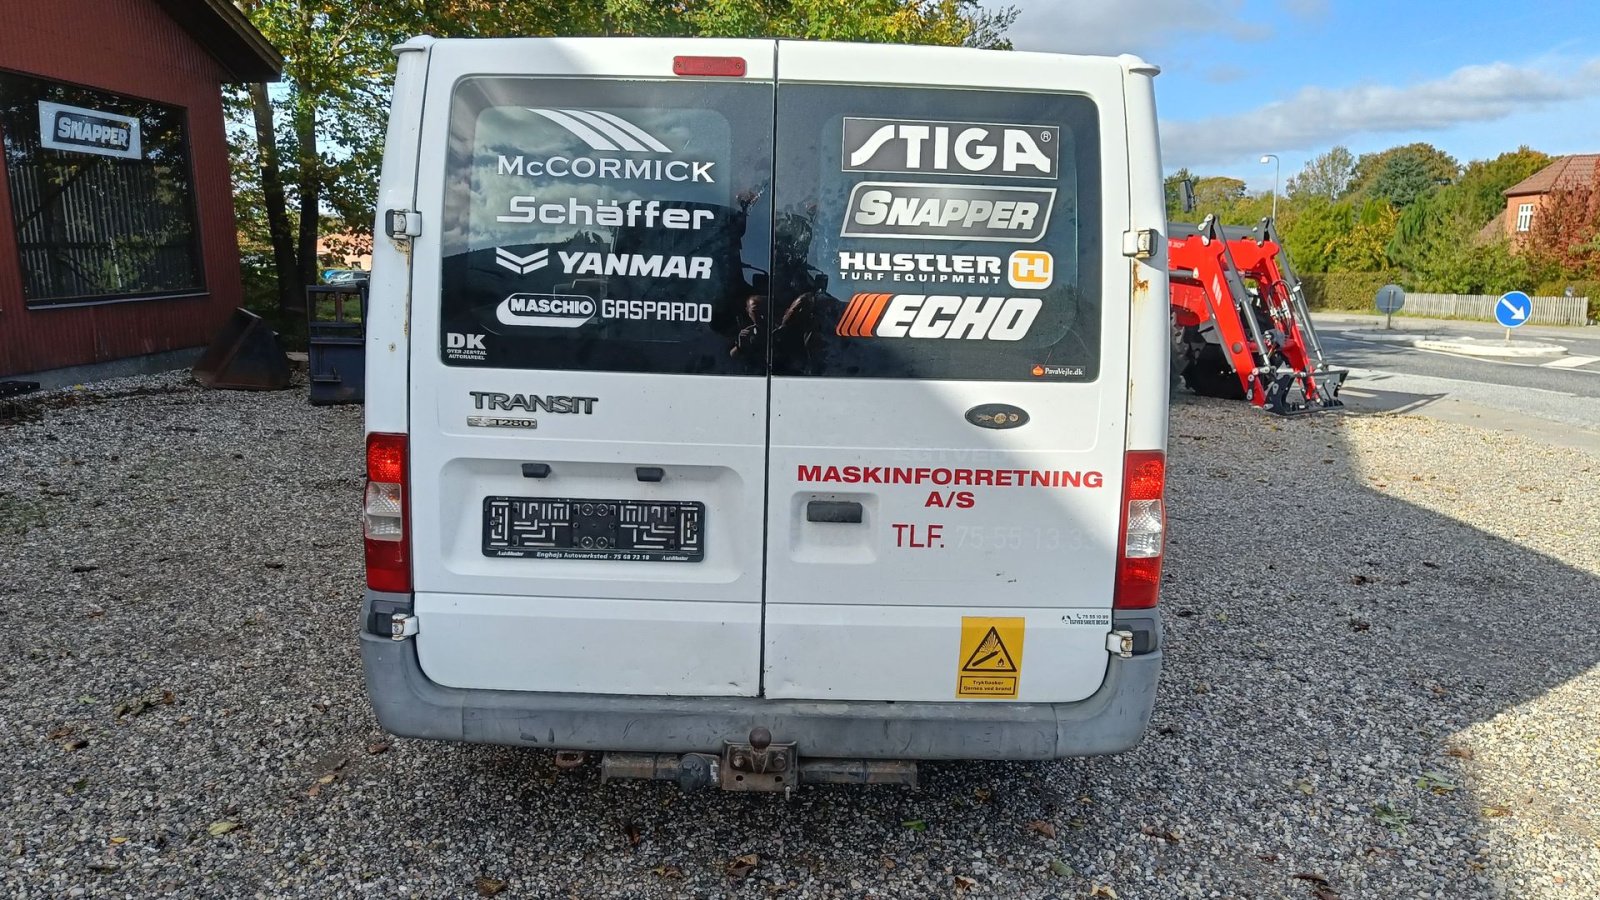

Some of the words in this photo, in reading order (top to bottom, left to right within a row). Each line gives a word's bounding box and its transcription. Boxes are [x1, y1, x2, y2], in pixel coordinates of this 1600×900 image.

[58, 117, 127, 147] SNAPPER
[851, 124, 1051, 173] STIGA
[496, 155, 716, 183] McCORMICK
[496, 196, 715, 230] Schäffer
[854, 190, 1039, 230] SNAPPER
[558, 250, 713, 279] YANMAR
[838, 252, 1002, 274] HUSTLER
[840, 271, 885, 281] TURF
[893, 272, 1001, 284] EQUIPMENT
[510, 298, 594, 314] MASCHIO
[601, 299, 713, 323] GASPARDO
[876, 294, 1043, 341] ECHO
[447, 332, 486, 349] DK
[469, 391, 599, 415] TRANSIT
[797, 465, 1103, 488] MASKINFORRETNING
[924, 491, 975, 508] A/S
[892, 524, 945, 548] TLF.
